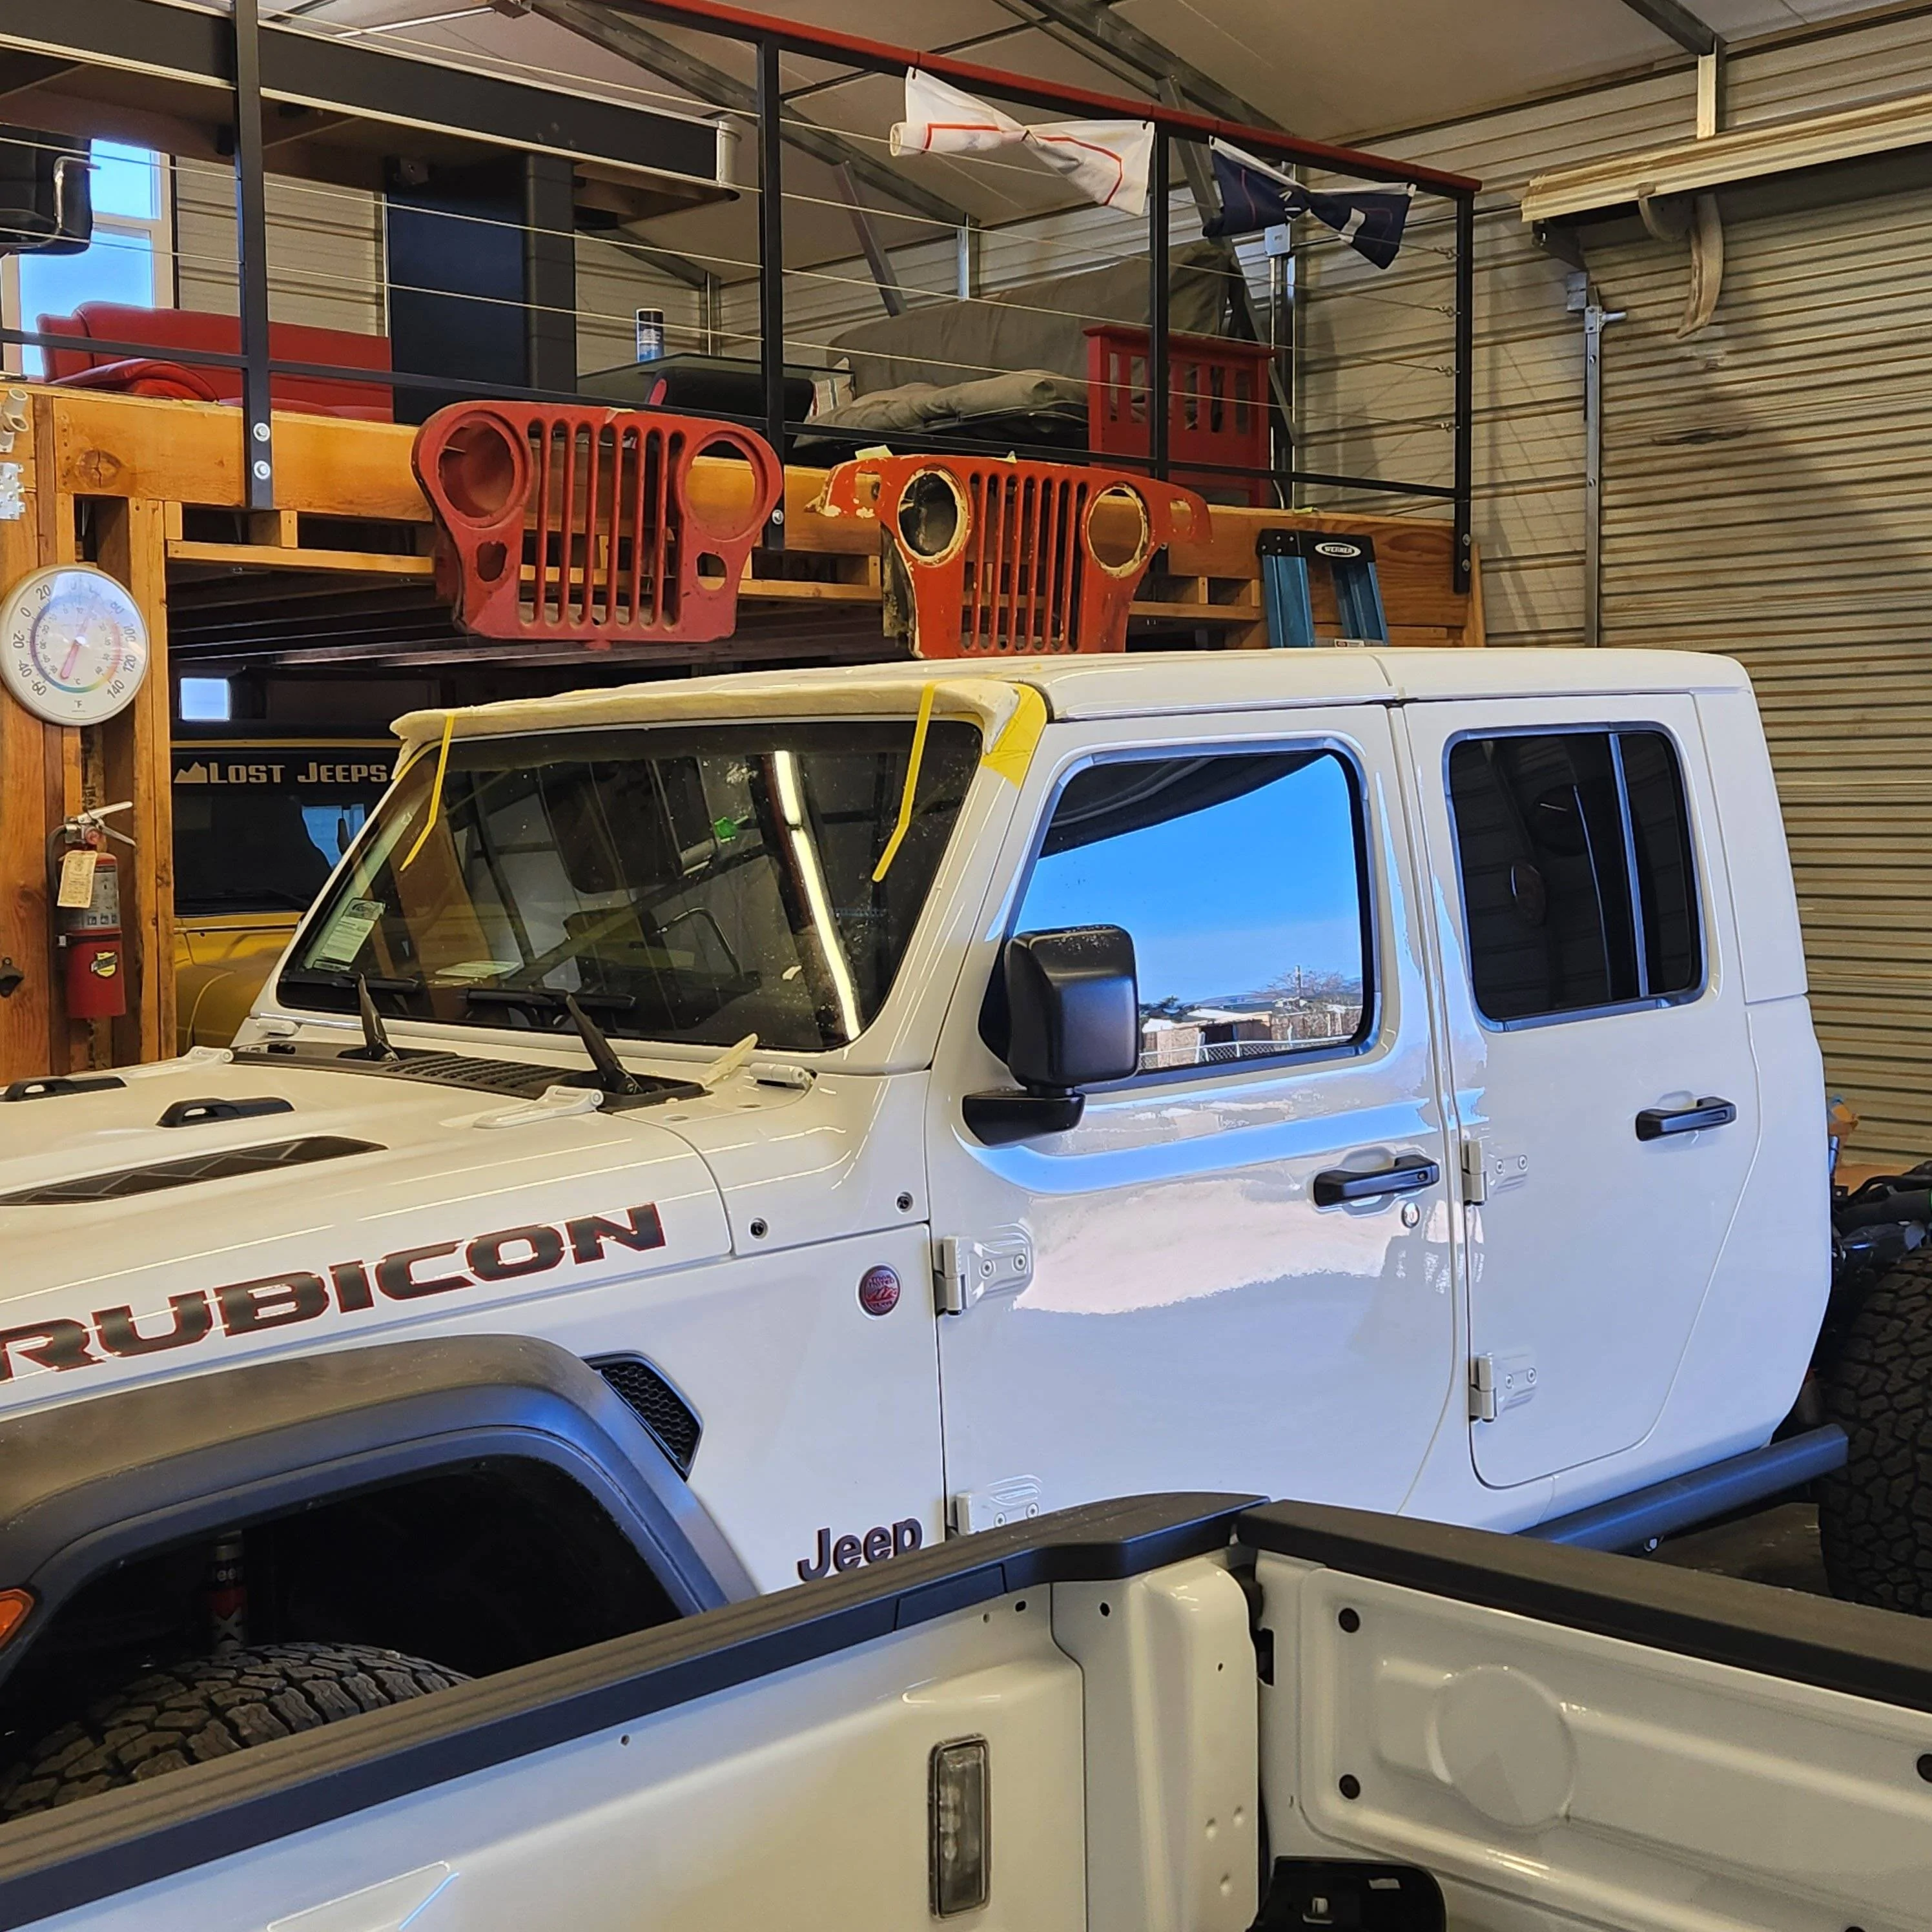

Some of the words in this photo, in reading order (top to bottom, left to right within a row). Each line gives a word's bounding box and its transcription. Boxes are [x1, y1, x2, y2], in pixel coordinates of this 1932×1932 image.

[36, 584, 51, 601] 20
[20, 607, 32, 618] 0
[12, 629, 25, 649] -20
[123, 622, 137, 642] 100
[18, 659, 33, 678] -40
[123, 654, 137, 672] 120
[31, 679, 47, 697] -60
[107, 679, 125, 699] 140
[0, 1202, 666, 1384] RUBICON
[797, 1517, 923, 1582] Jeep
